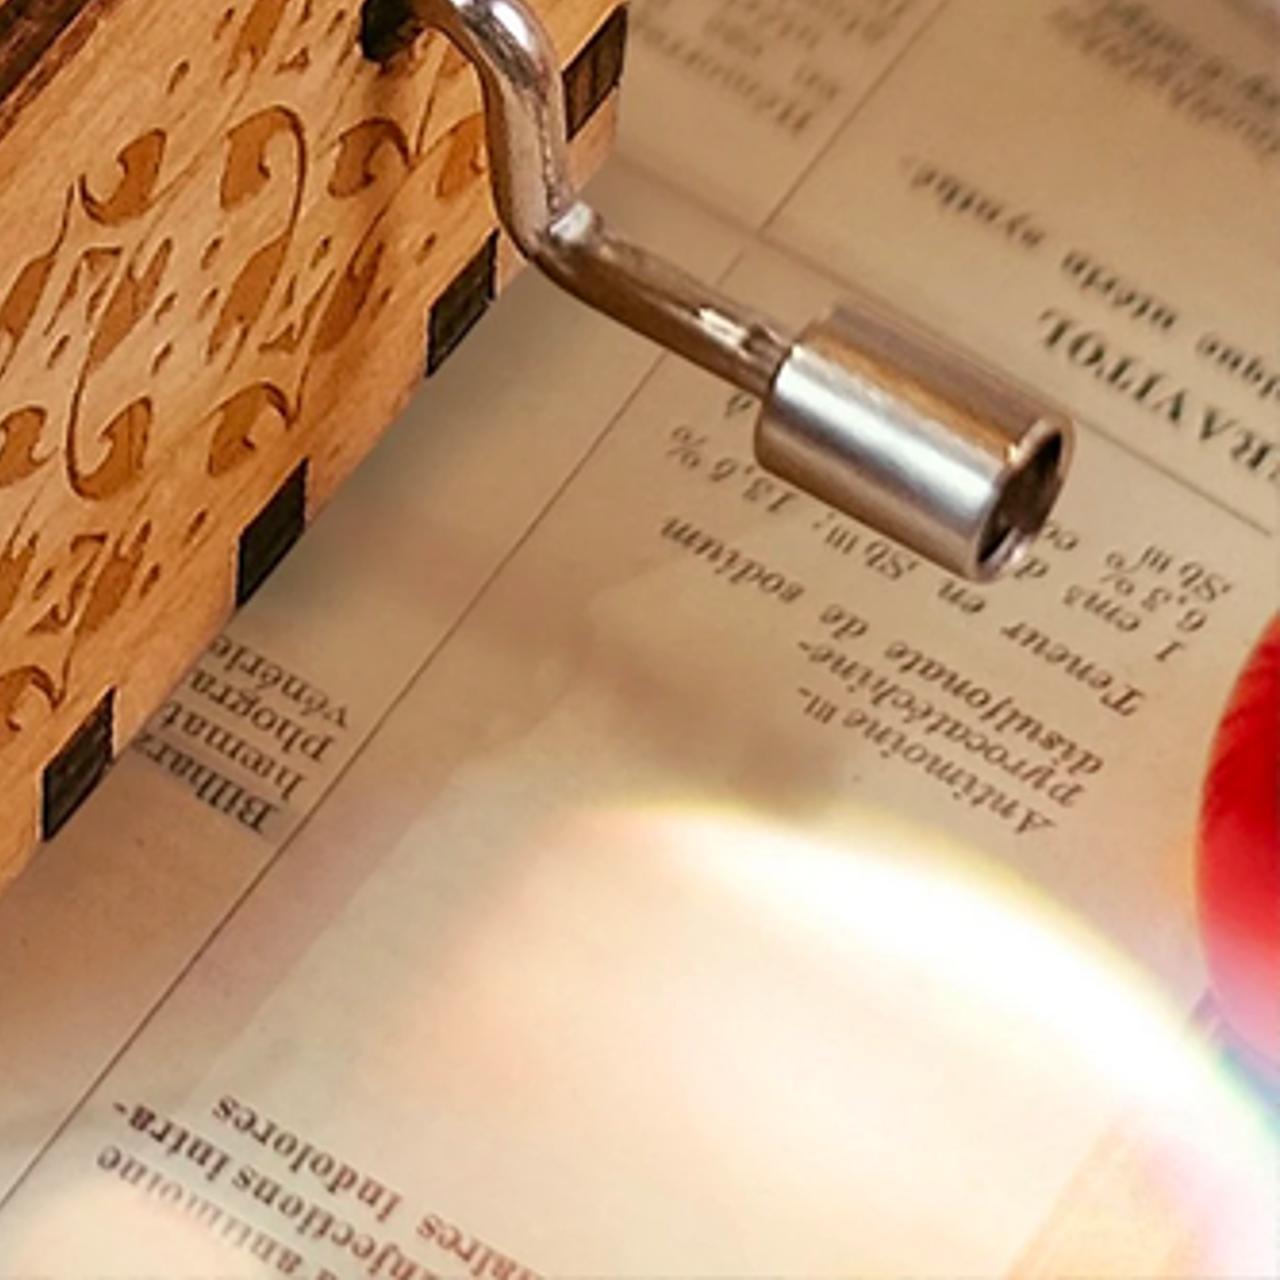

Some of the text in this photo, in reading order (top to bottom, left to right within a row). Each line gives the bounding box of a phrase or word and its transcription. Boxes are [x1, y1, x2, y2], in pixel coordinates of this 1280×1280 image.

[1037, 310, 1280, 482] RAVITOL
[660, 517, 1105, 778] disulfonate de sodium
[936, 580, 986, 618] en
[191, 670, 334, 763] phogra
[1000, 623, 1145, 717] Teneur
[841, 709, 1056, 836] Antimoine
[111, 1100, 439, 1280] njections intra-
[211, 1093, 402, 1223] indolores
